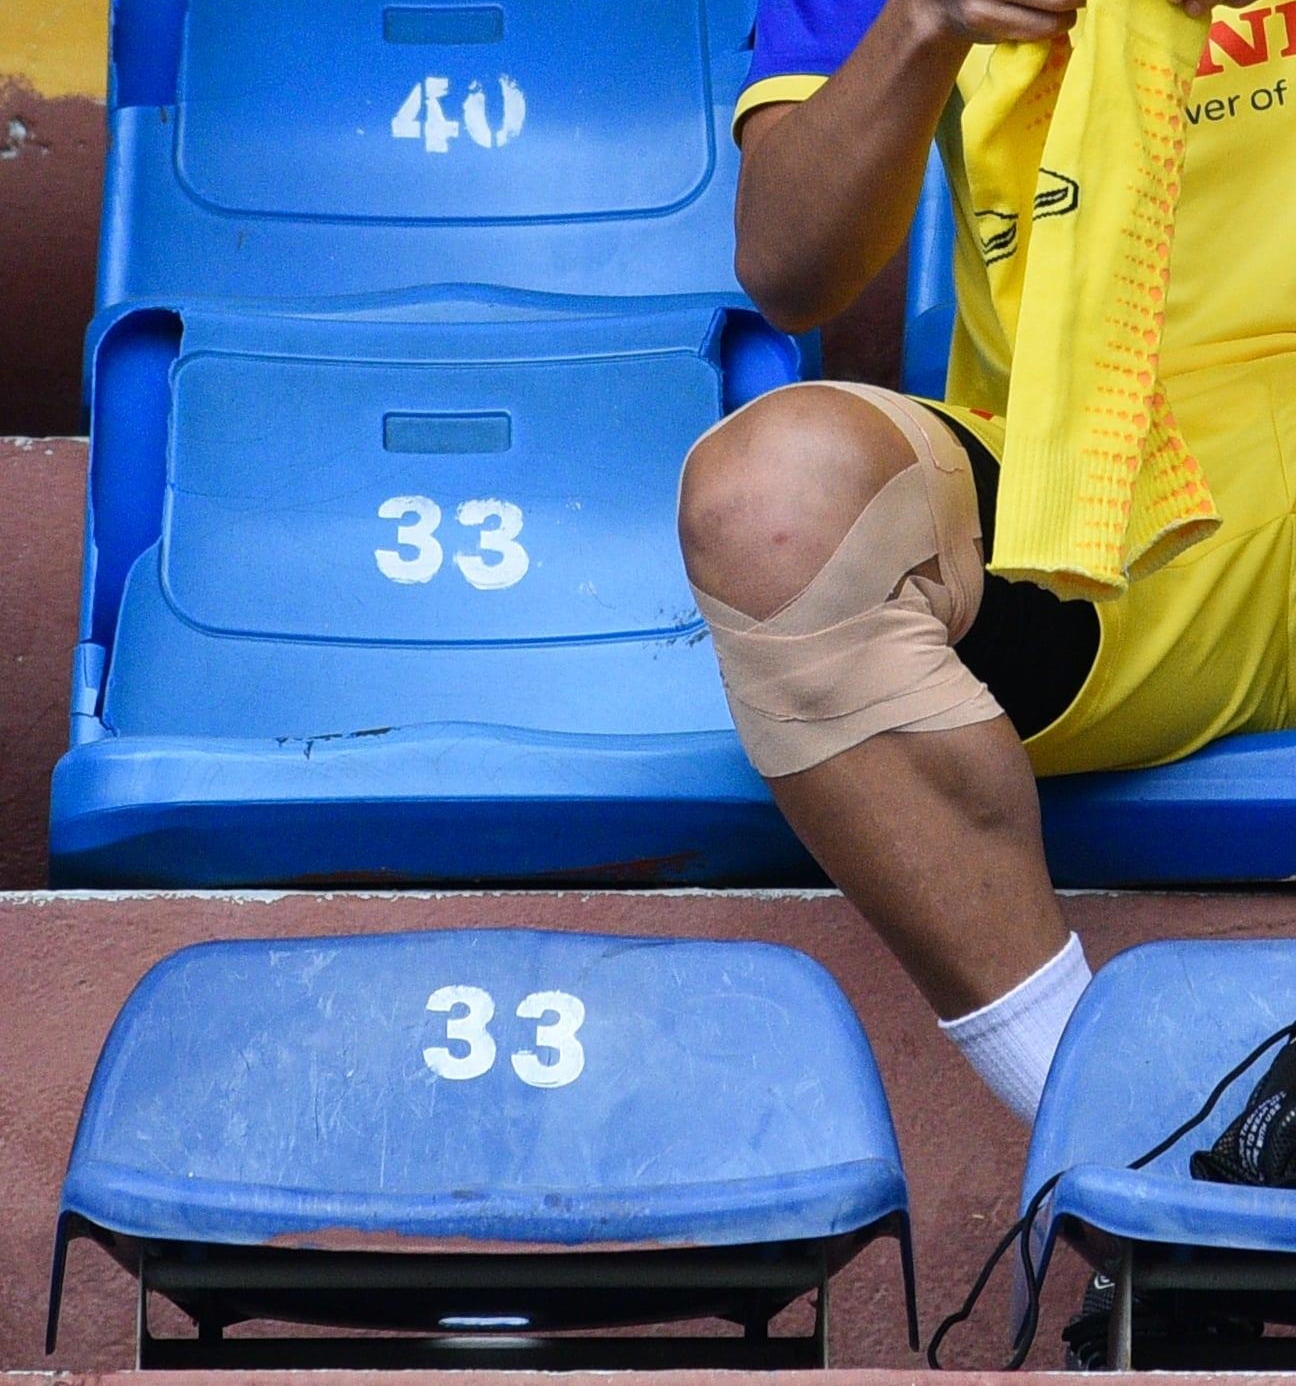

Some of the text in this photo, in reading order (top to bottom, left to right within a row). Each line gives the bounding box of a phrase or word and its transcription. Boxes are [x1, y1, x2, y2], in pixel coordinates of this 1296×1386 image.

[389, 74, 527, 154] 40
[1185, 94, 1241, 125] ver
[1250, 79, 1288, 111] of
[374, 495, 530, 590] 33
[422, 984, 587, 1089] 33
